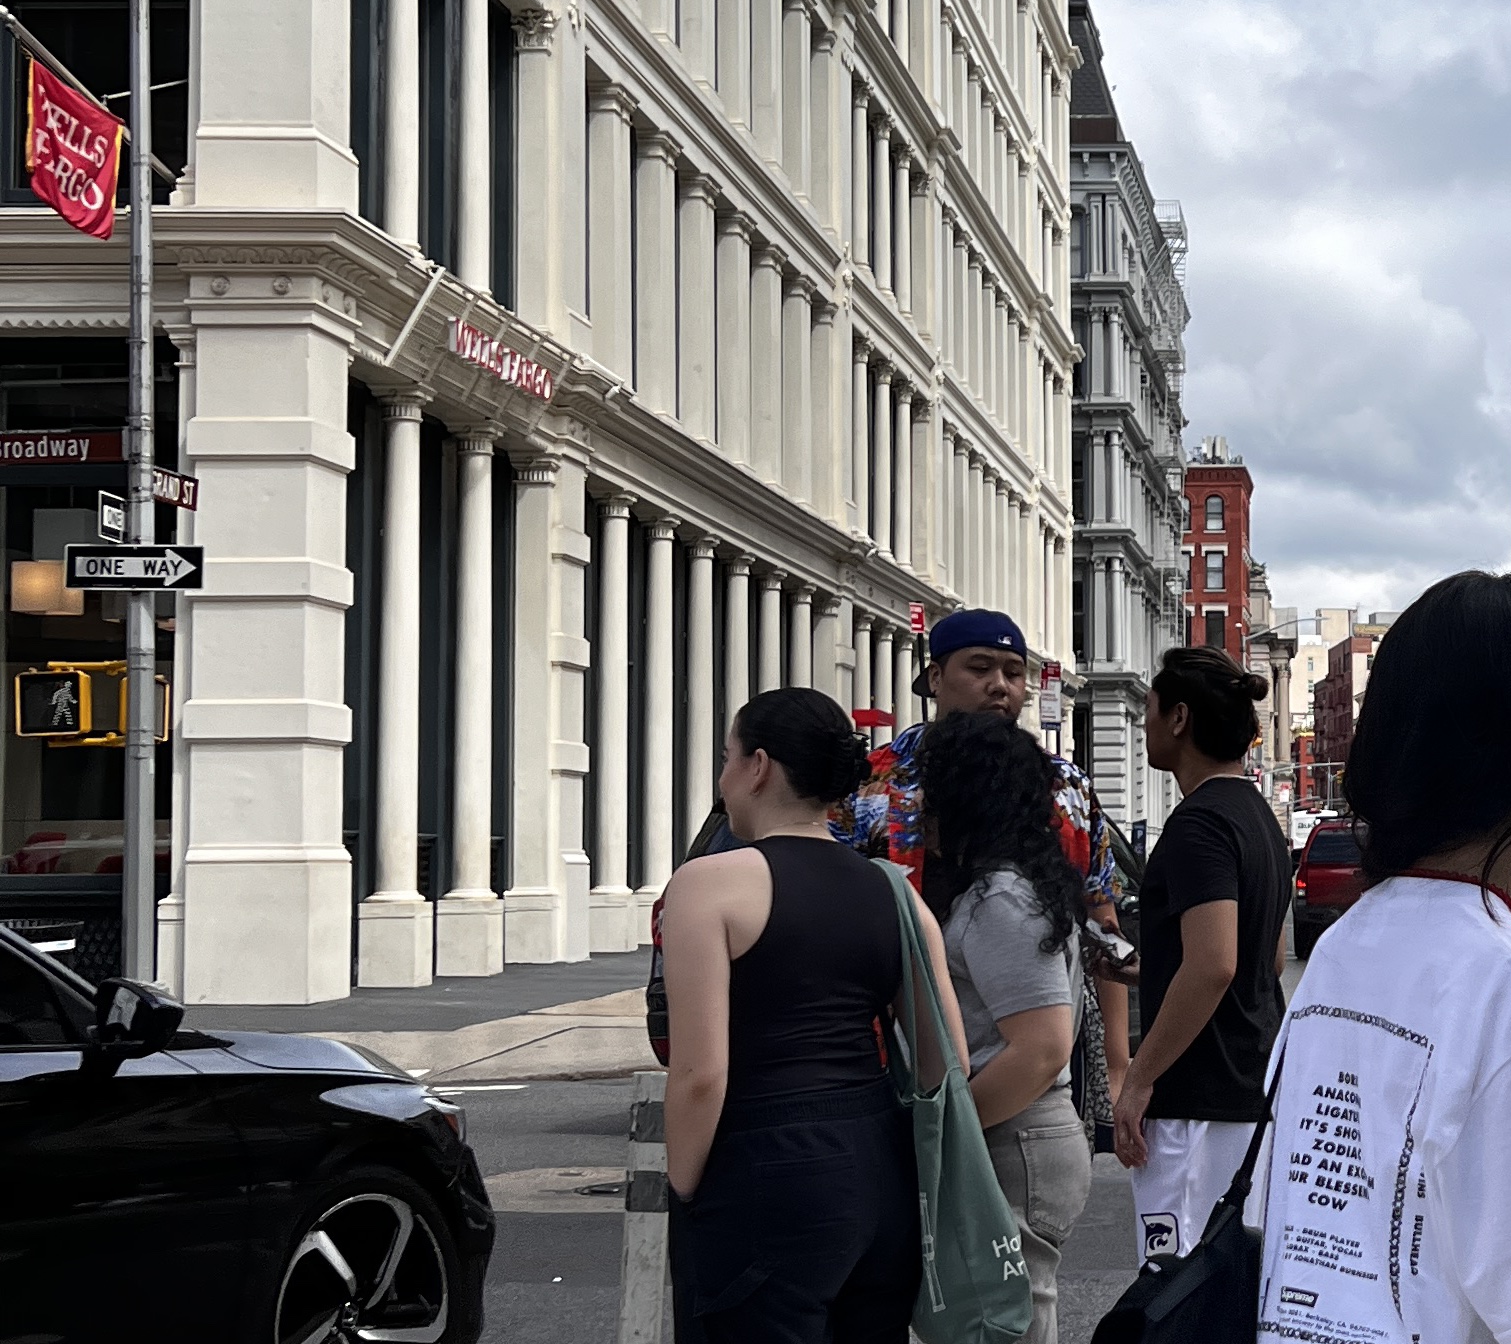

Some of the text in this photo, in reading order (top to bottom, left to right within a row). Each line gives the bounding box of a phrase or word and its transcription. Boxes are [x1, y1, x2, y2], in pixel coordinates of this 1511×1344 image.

[0, 436, 90, 461] roadway
[182, 479, 196, 506] ST
[86, 559, 183, 577] ONE WAY
[1316, 1102, 1360, 1123] LIGATU
[1299, 1117, 1329, 1134] IT'S
[1317, 1158, 1343, 1174] AN
[1308, 1191, 1348, 1212] COW
[1282, 1287, 1316, 1304] Spreme
